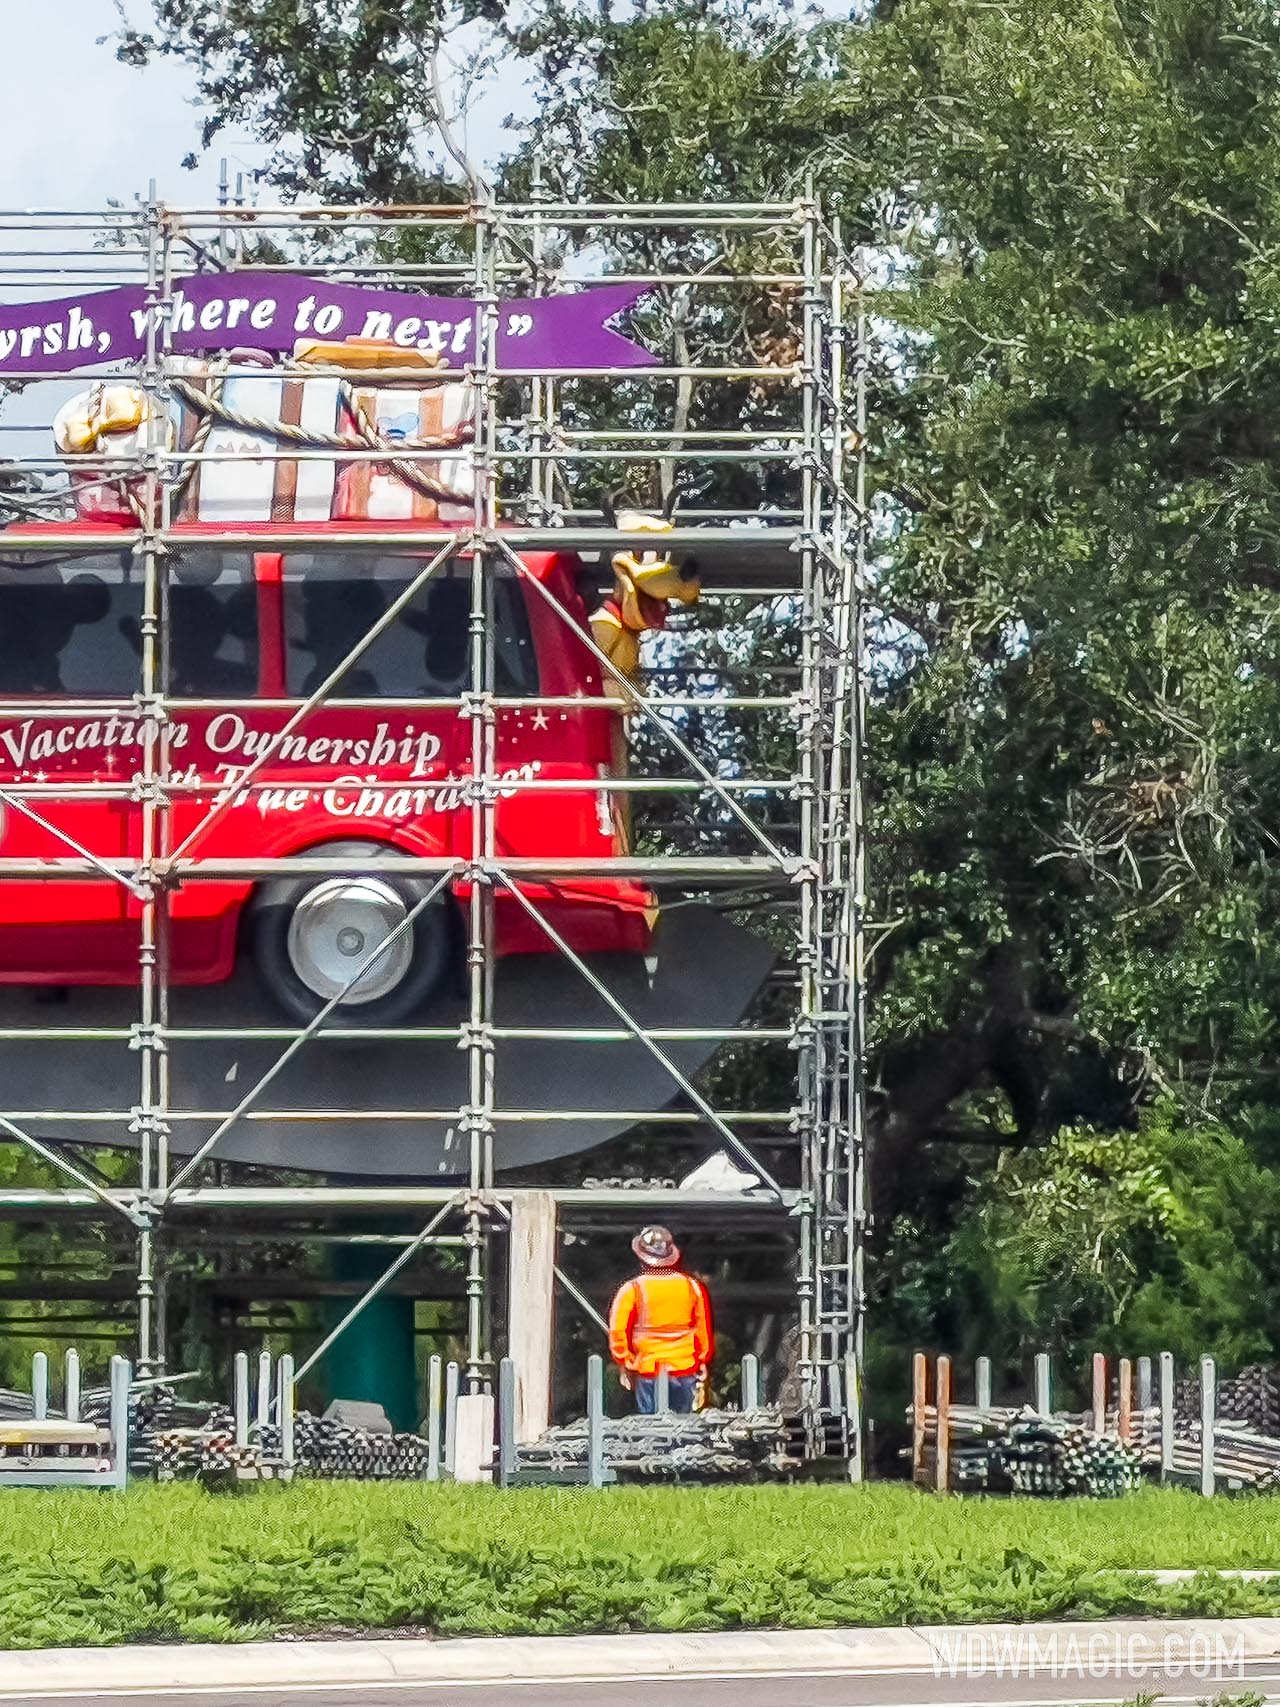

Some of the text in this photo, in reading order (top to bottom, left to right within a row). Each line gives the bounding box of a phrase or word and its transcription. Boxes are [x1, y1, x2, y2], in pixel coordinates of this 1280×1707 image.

[130, 290, 277, 339] where
[294, 295, 343, 334] to
[205, 713, 440, 777] Ownership
[323, 760, 542, 817] Charaer
